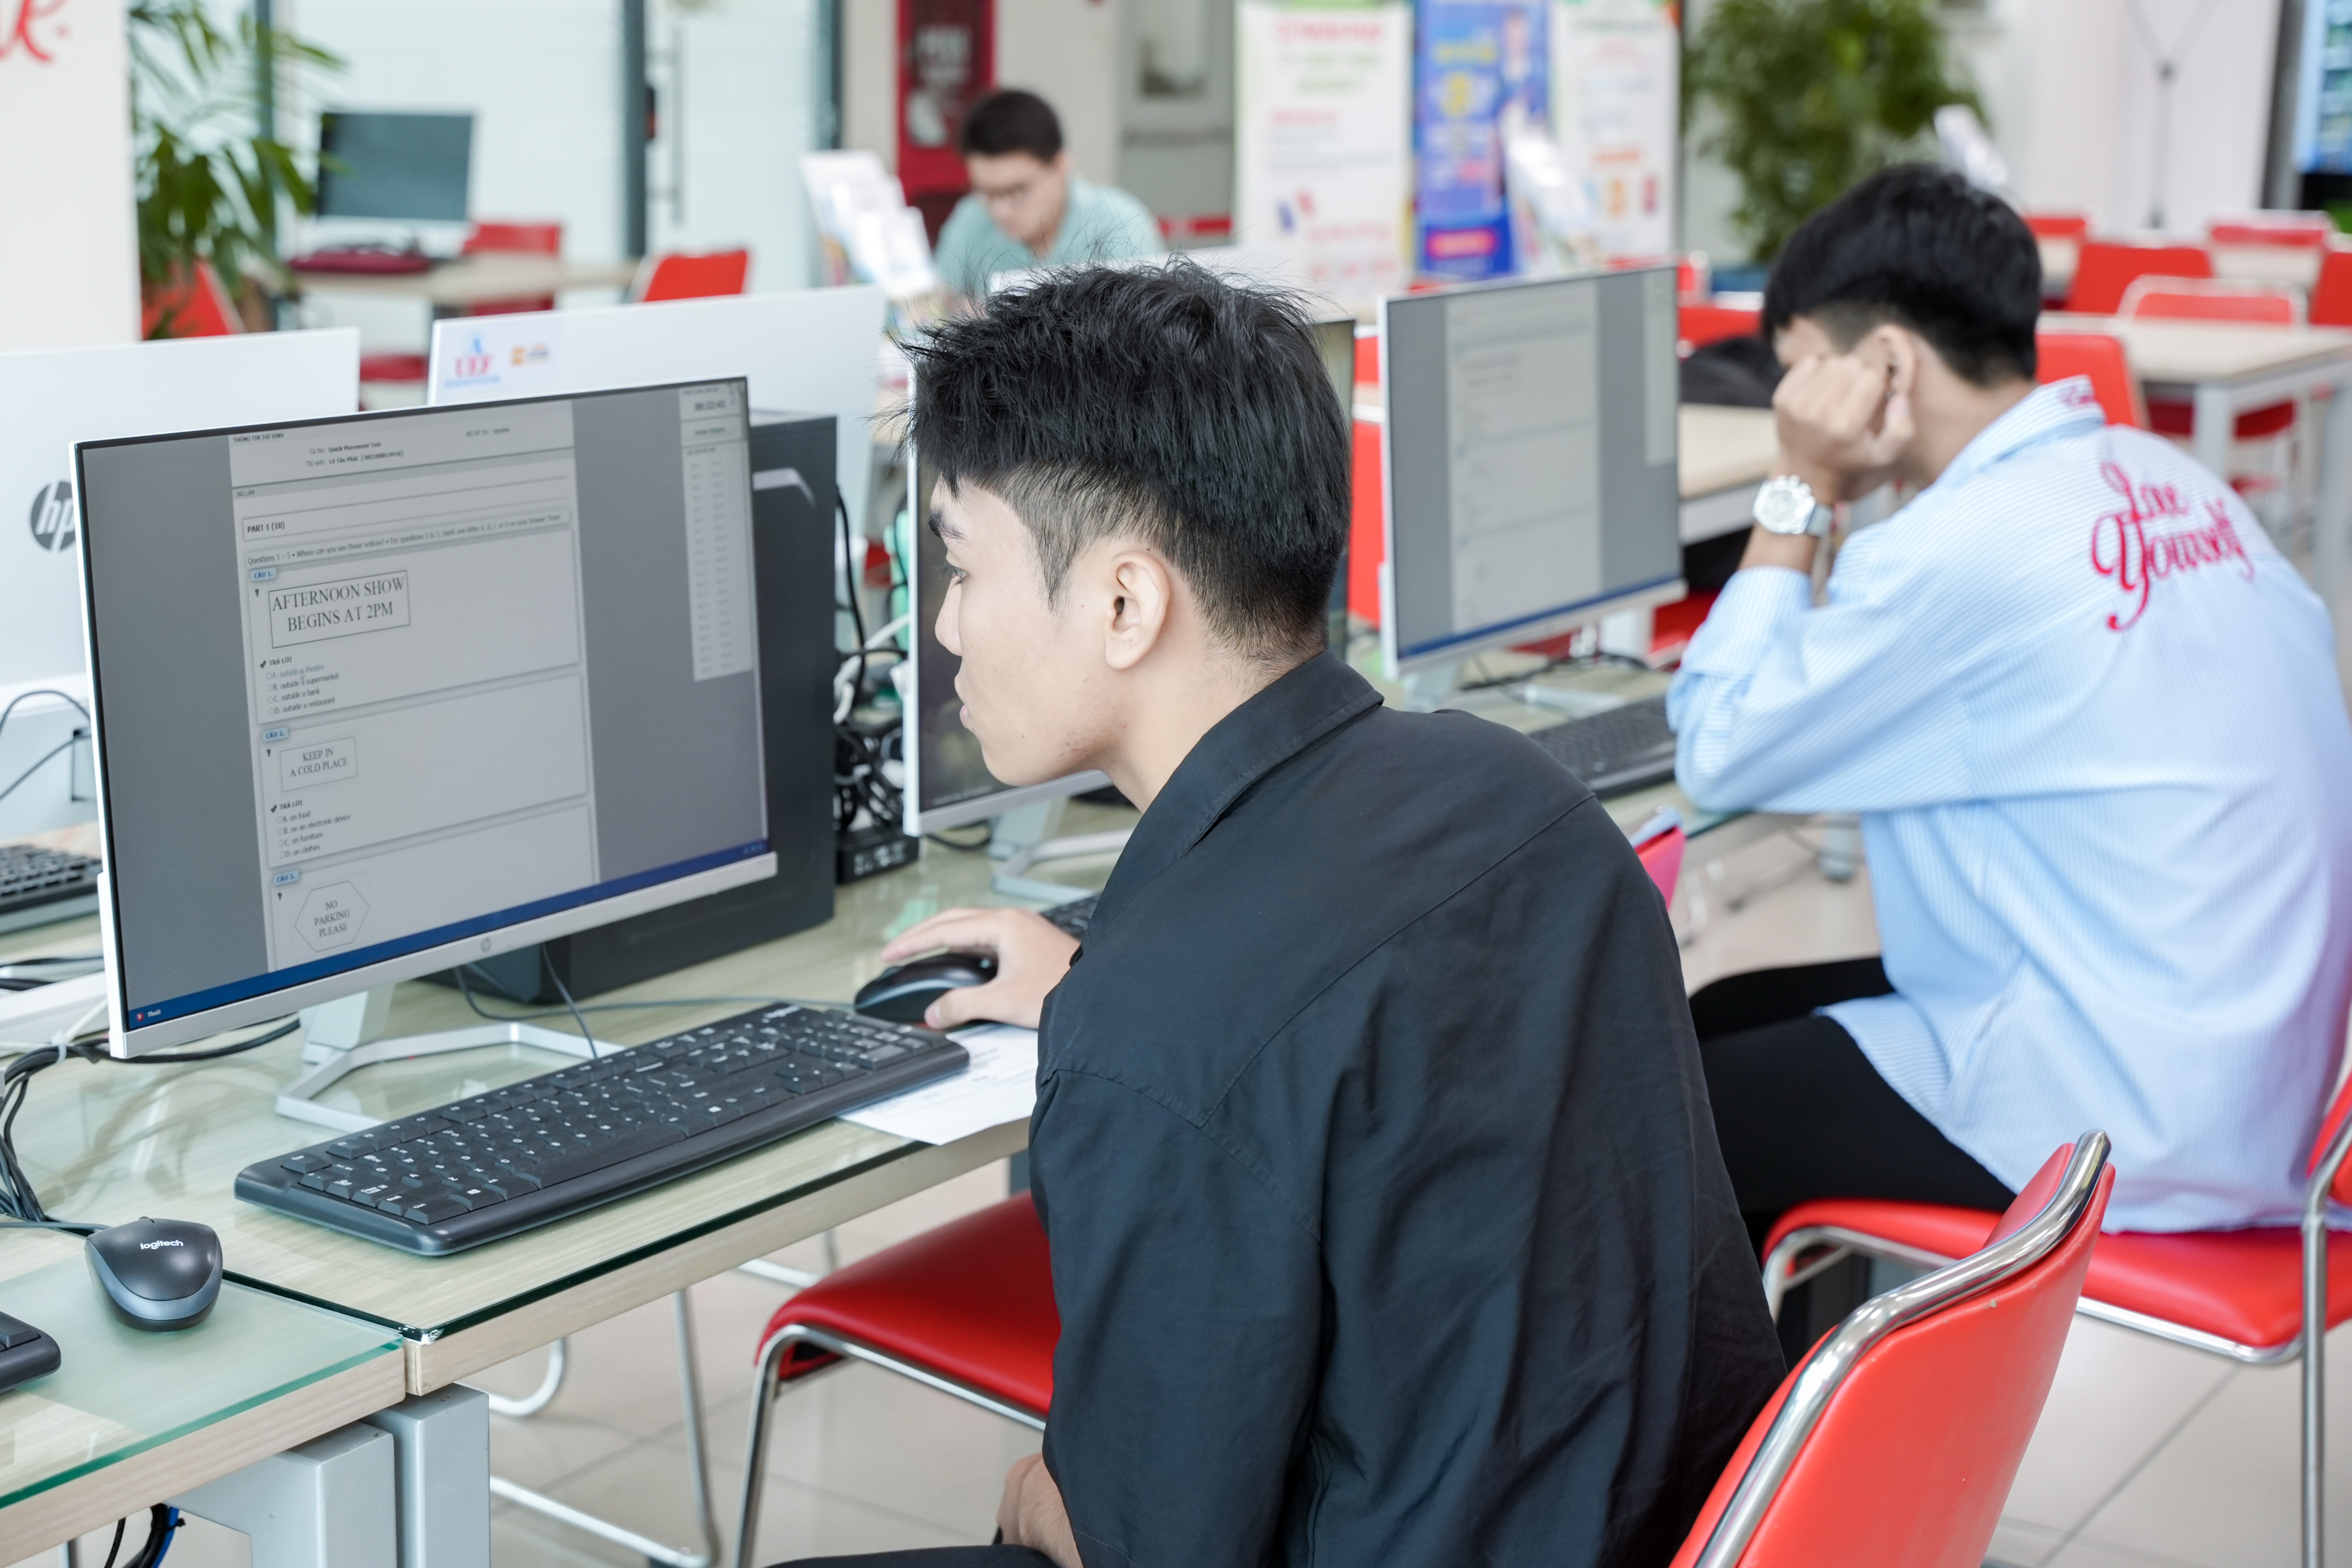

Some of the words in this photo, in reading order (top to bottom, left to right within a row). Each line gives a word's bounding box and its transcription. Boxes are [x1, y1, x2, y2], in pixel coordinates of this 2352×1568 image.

[247, 525, 264, 533] PART
[271, 521, 285, 531] (10)
[248, 556, 275, 565] Questions
[297, 549, 314, 557] Where
[327, 547, 337, 555] you
[273, 583, 360, 611] AFTERNOON
[364, 576, 405, 596] SHOW
[287, 610, 340, 632] BEGINS
[344, 606, 363, 623] AT
[367, 601, 393, 619] 2PM
[280, 668, 300, 678] outside
[305, 664, 324, 672] theatre
[280, 681, 300, 690] outside
[306, 673, 339, 684] supermarket
[281, 692, 301, 702] outside
[307, 688, 320, 697] bank
[282, 703, 302, 713] outside
[308, 697, 335, 708] restaurant
[302, 750, 323, 762] KEEP
[325, 747, 334, 757] IN
[290, 769, 296, 777] A
[298, 763, 321, 775] COLD
[323, 757, 348, 771] PLACE
[298, 811, 311, 820] food
[308, 818, 332, 829] electronic
[334, 814, 351, 823] device
[300, 832, 323, 842] furniture
[301, 845, 321, 854] clothes
[326, 900, 338, 911] NO
[314, 909, 350, 926] PARKING
[319, 922, 348, 938] PLEASE
[140, 1240, 183, 1250] logitech
